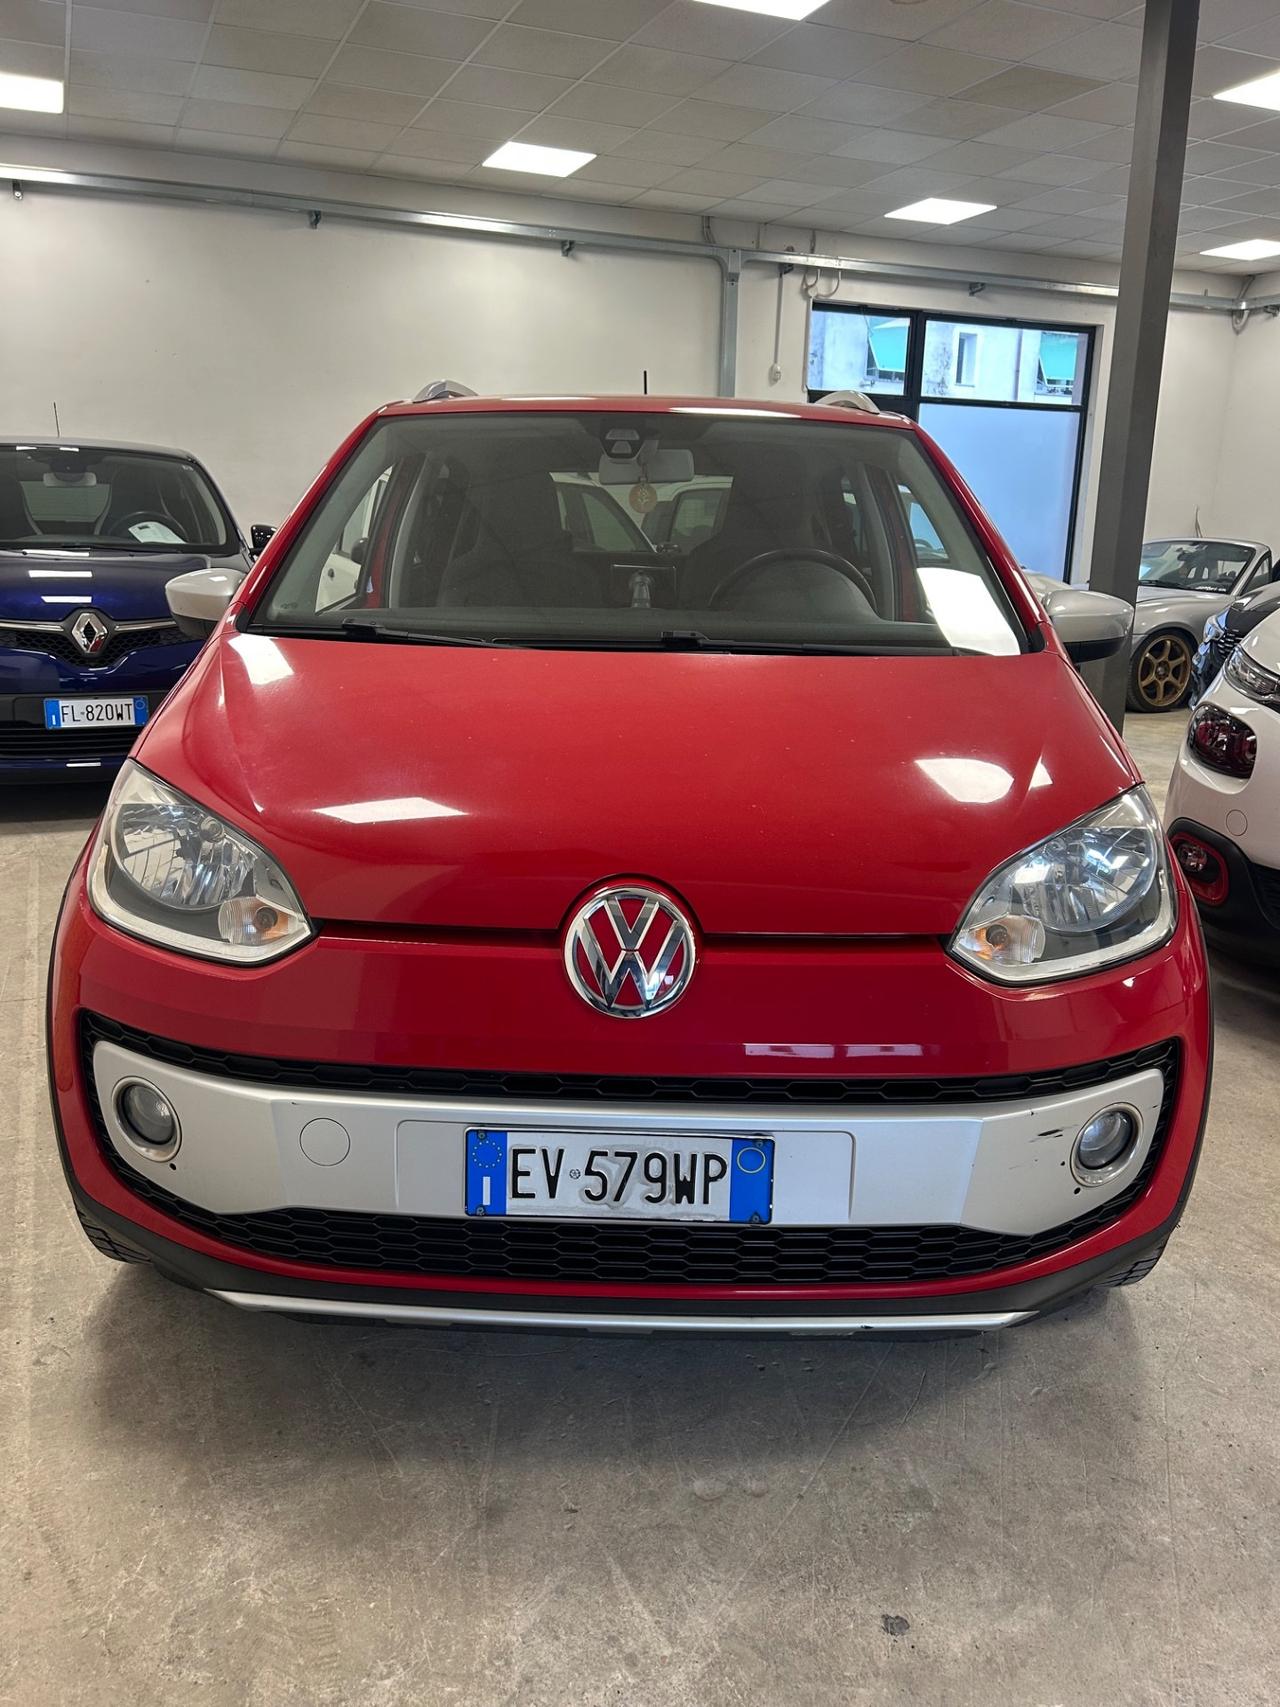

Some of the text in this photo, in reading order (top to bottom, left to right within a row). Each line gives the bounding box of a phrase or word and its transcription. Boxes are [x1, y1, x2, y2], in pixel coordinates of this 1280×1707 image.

[61, 705, 80, 722] FL
[86, 703, 132, 721] 820WT
[570, 891, 690, 1014] VW
[511, 1148, 564, 1199] EV
[584, 1150, 728, 1205] 579WP
